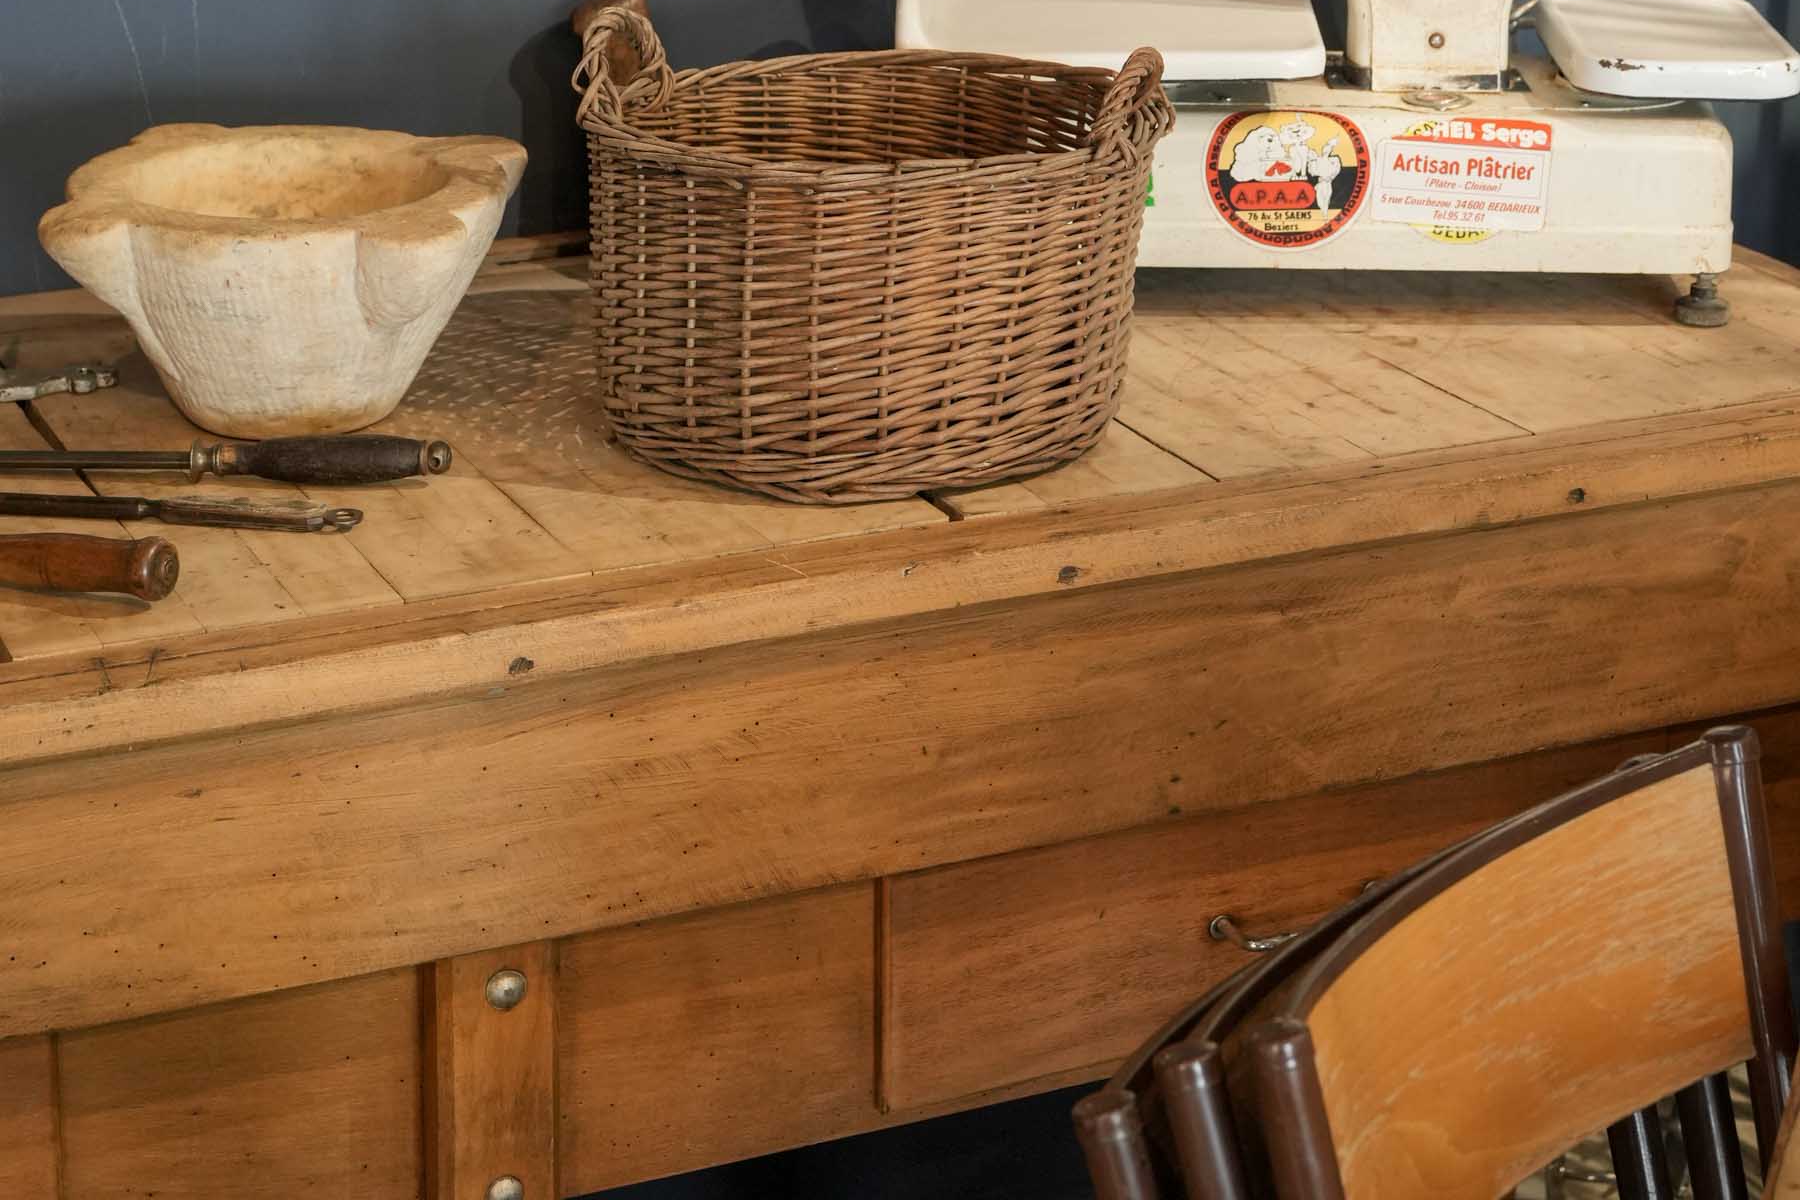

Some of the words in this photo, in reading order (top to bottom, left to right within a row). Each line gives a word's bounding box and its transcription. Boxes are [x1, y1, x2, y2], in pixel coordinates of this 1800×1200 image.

[1481, 122, 1548, 148] Serge
[1392, 153, 1460, 175] Artisan
[1466, 156, 1535, 181] Plâtrier
[1388, 196, 1403, 204] rue
[1454, 200, 1485, 210] 34600
[1487, 202, 1541, 215] BEDARIEUX
